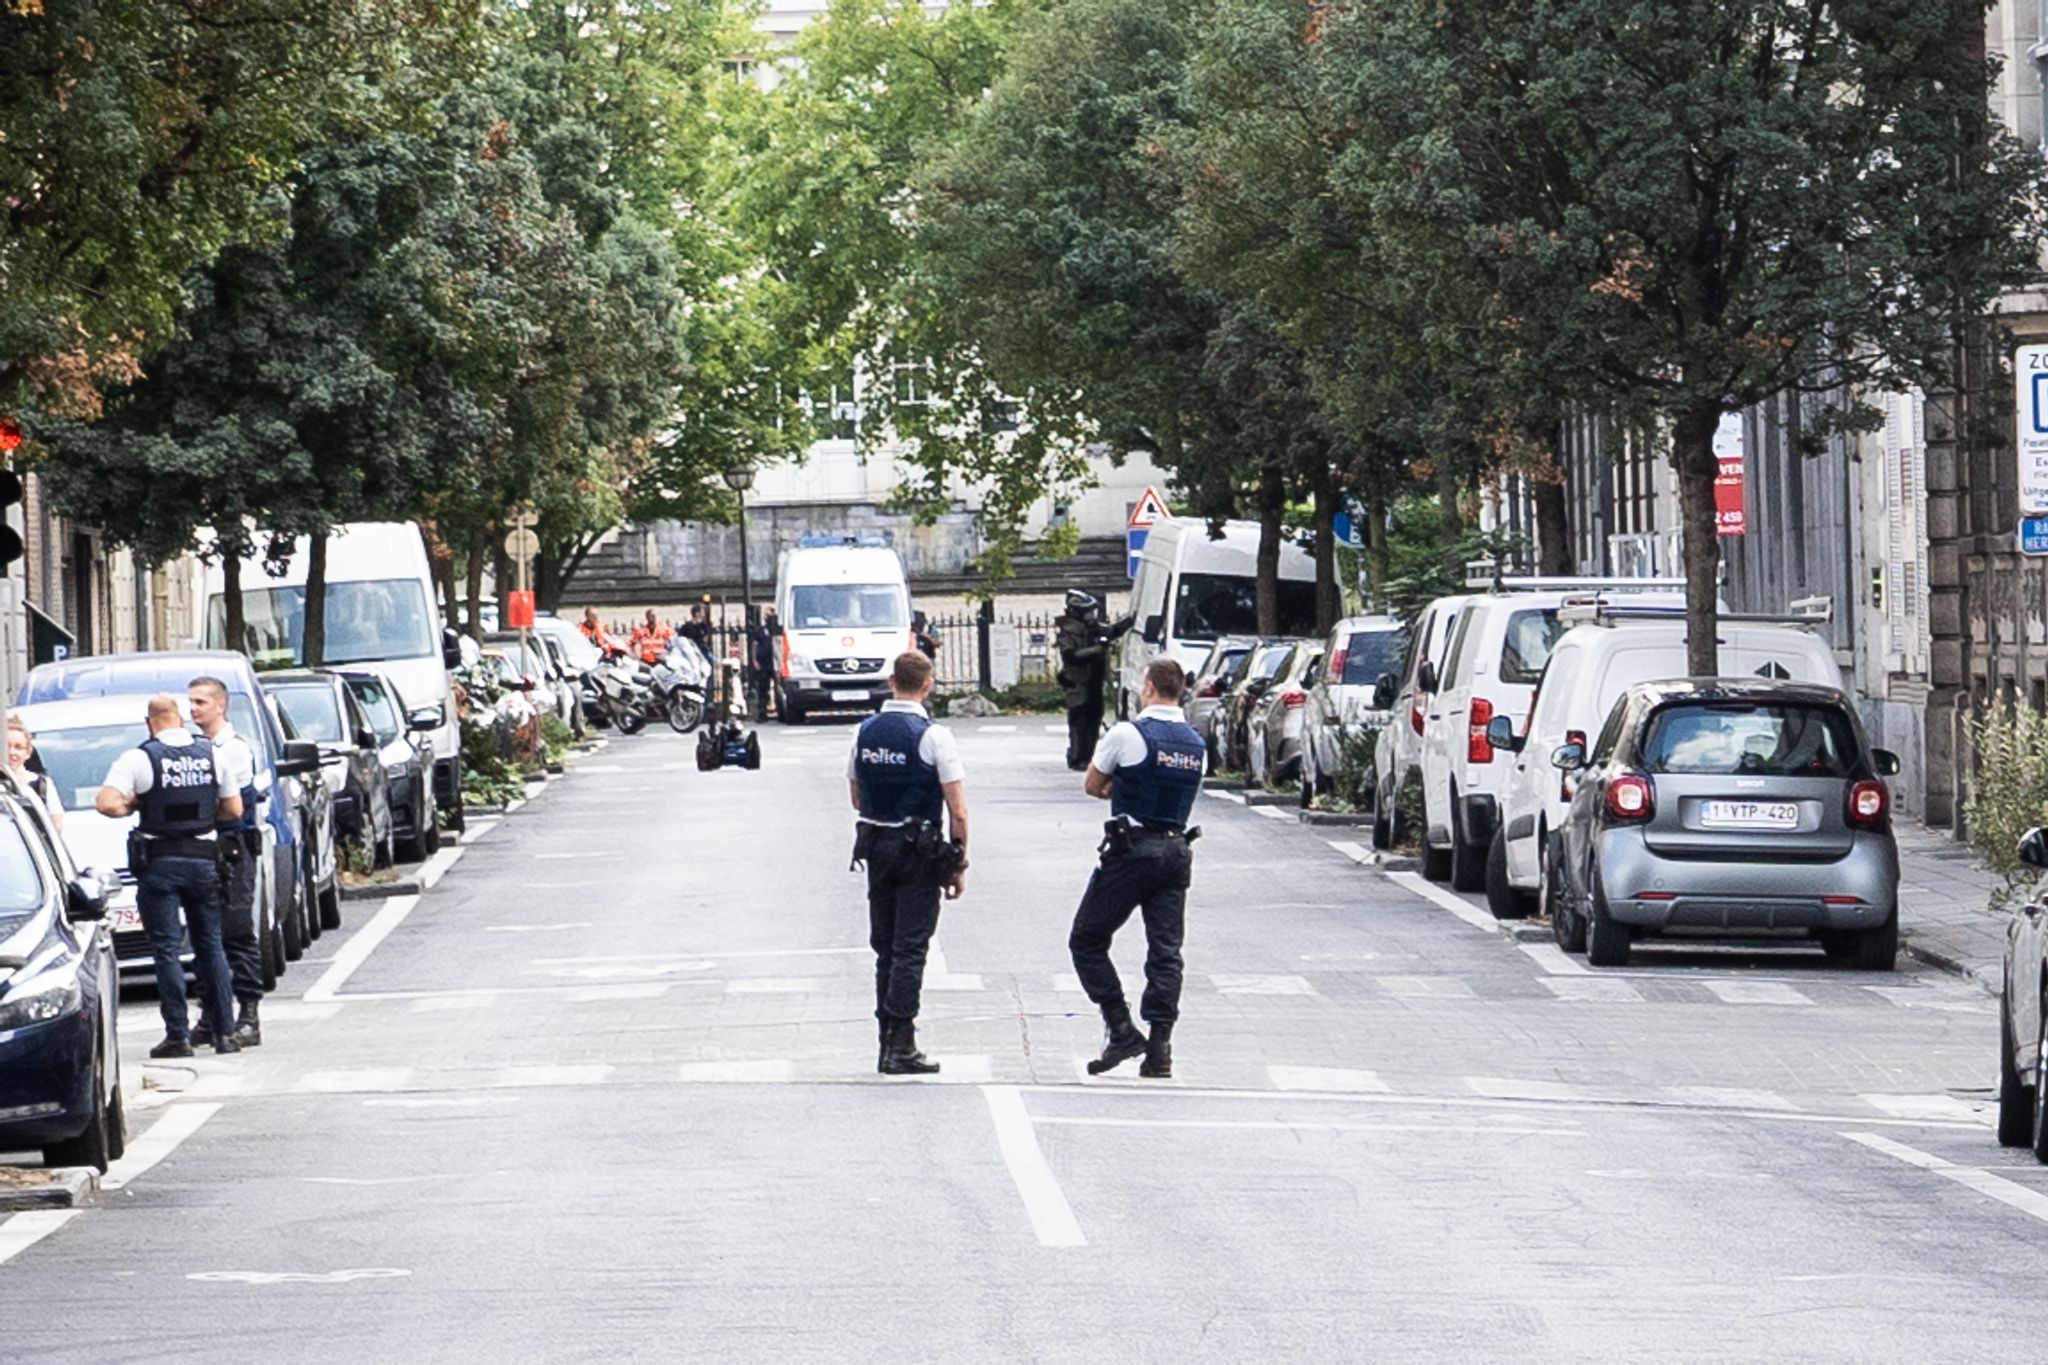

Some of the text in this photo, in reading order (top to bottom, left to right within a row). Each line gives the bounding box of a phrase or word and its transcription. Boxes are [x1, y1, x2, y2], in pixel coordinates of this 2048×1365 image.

[161, 756, 211, 773] Police
[862, 747, 906, 765] Police
[1157, 750, 1202, 771] Politie
[162, 768, 213, 788] Politie
